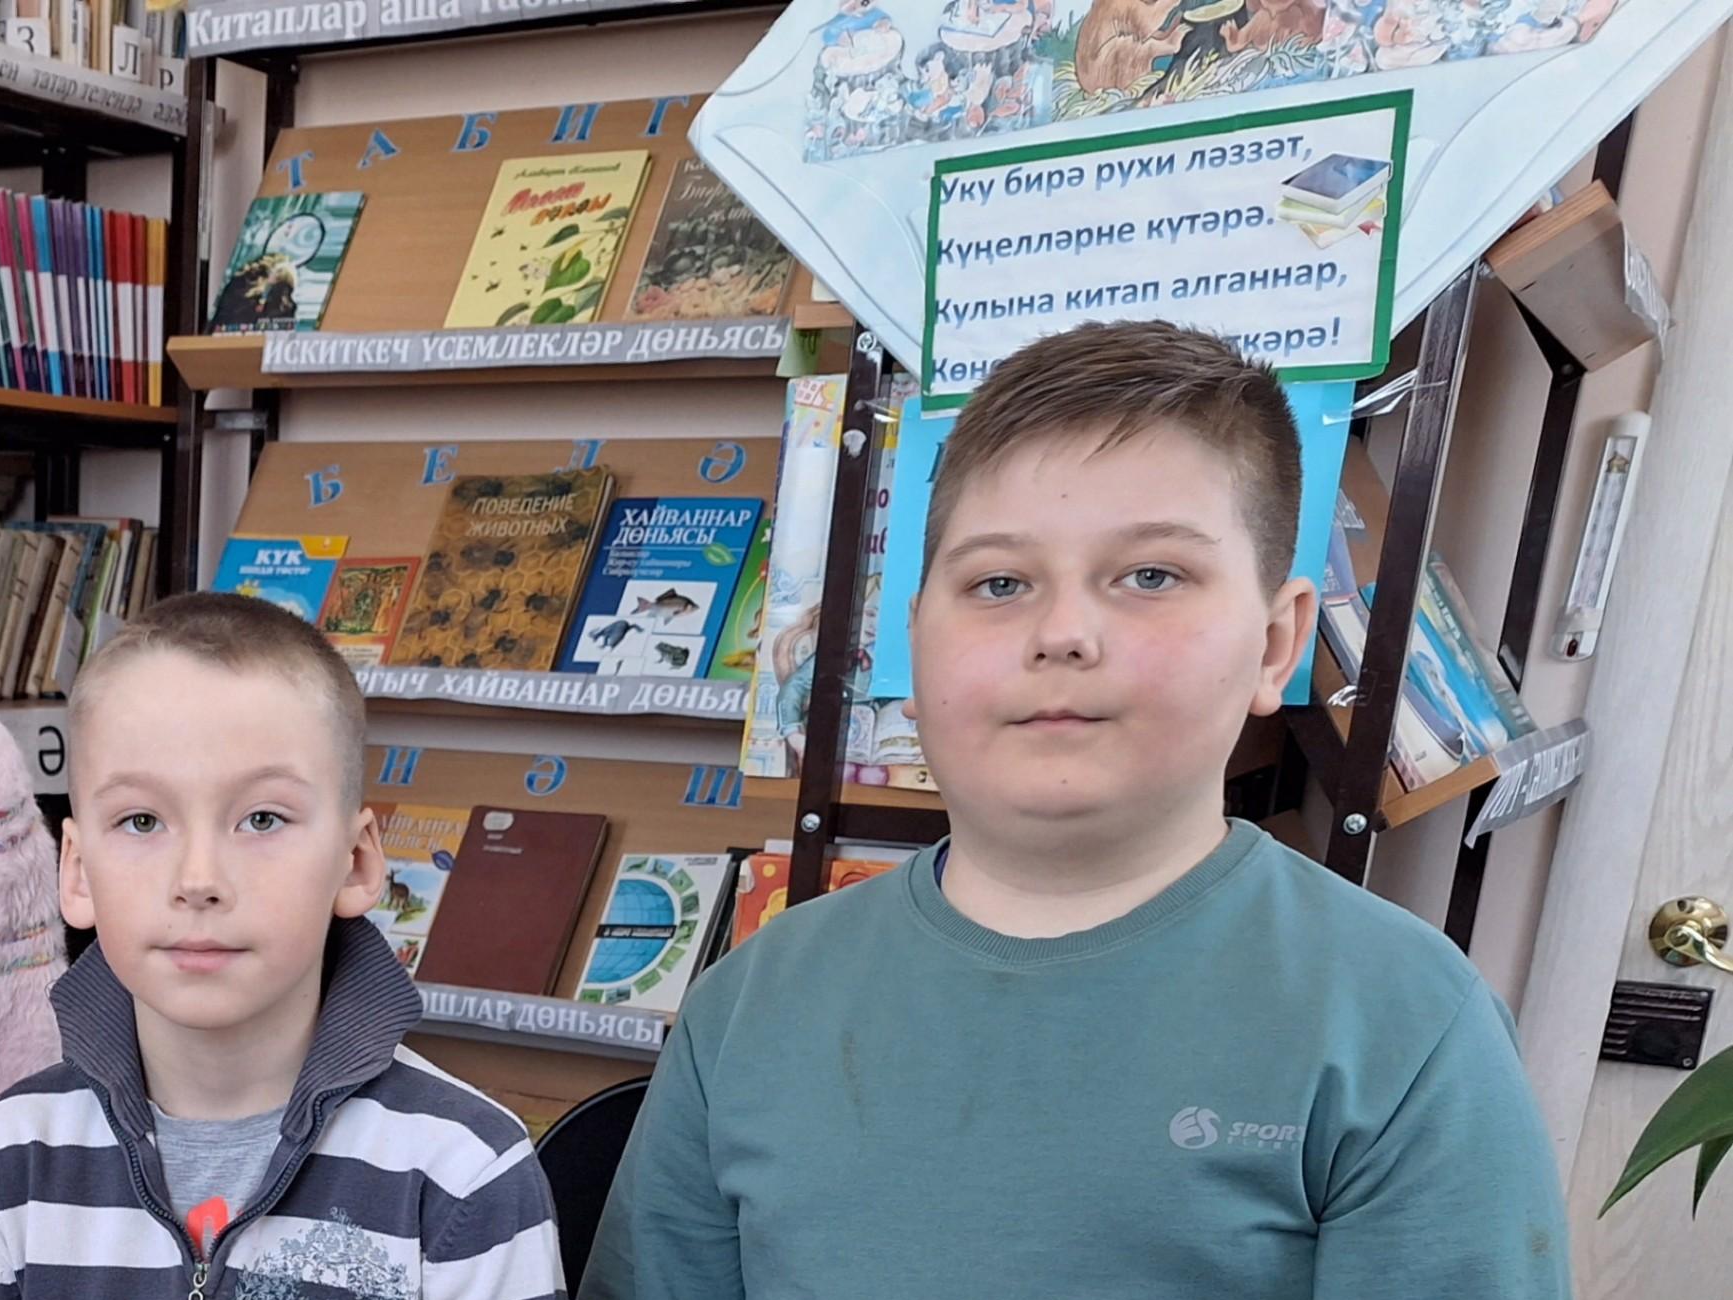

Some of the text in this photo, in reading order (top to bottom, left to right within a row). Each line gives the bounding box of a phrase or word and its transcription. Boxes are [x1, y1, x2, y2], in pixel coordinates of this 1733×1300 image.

[188, 0, 461, 48] Китаплар аша
[939, 134, 1313, 205] Уку бирә рухи ләззәт,
[937, 204, 1275, 269] Күңелләрне күтәрә.
[934, 259, 1349, 329] Кулына китап алганнар,
[262, 324, 792, 366] ИСКИТКЕЧ ҮСЕМЛЕКЛӘР ДӨНЬЯСЫ
[471, 493, 579, 516] ПОВЕДЕНИЕ
[620, 505, 752, 528] ХАЙВАННАР
[466, 517, 569, 537] ЖИВОТНЫХ
[612, 527, 718, 546] ДӨНЬЯСЫ
[254, 549, 304, 566] КҮК
[437, 672, 619, 709] ХАЙВАННАР
[516, 1004, 665, 1045] ДӨНЬЯСЫ
